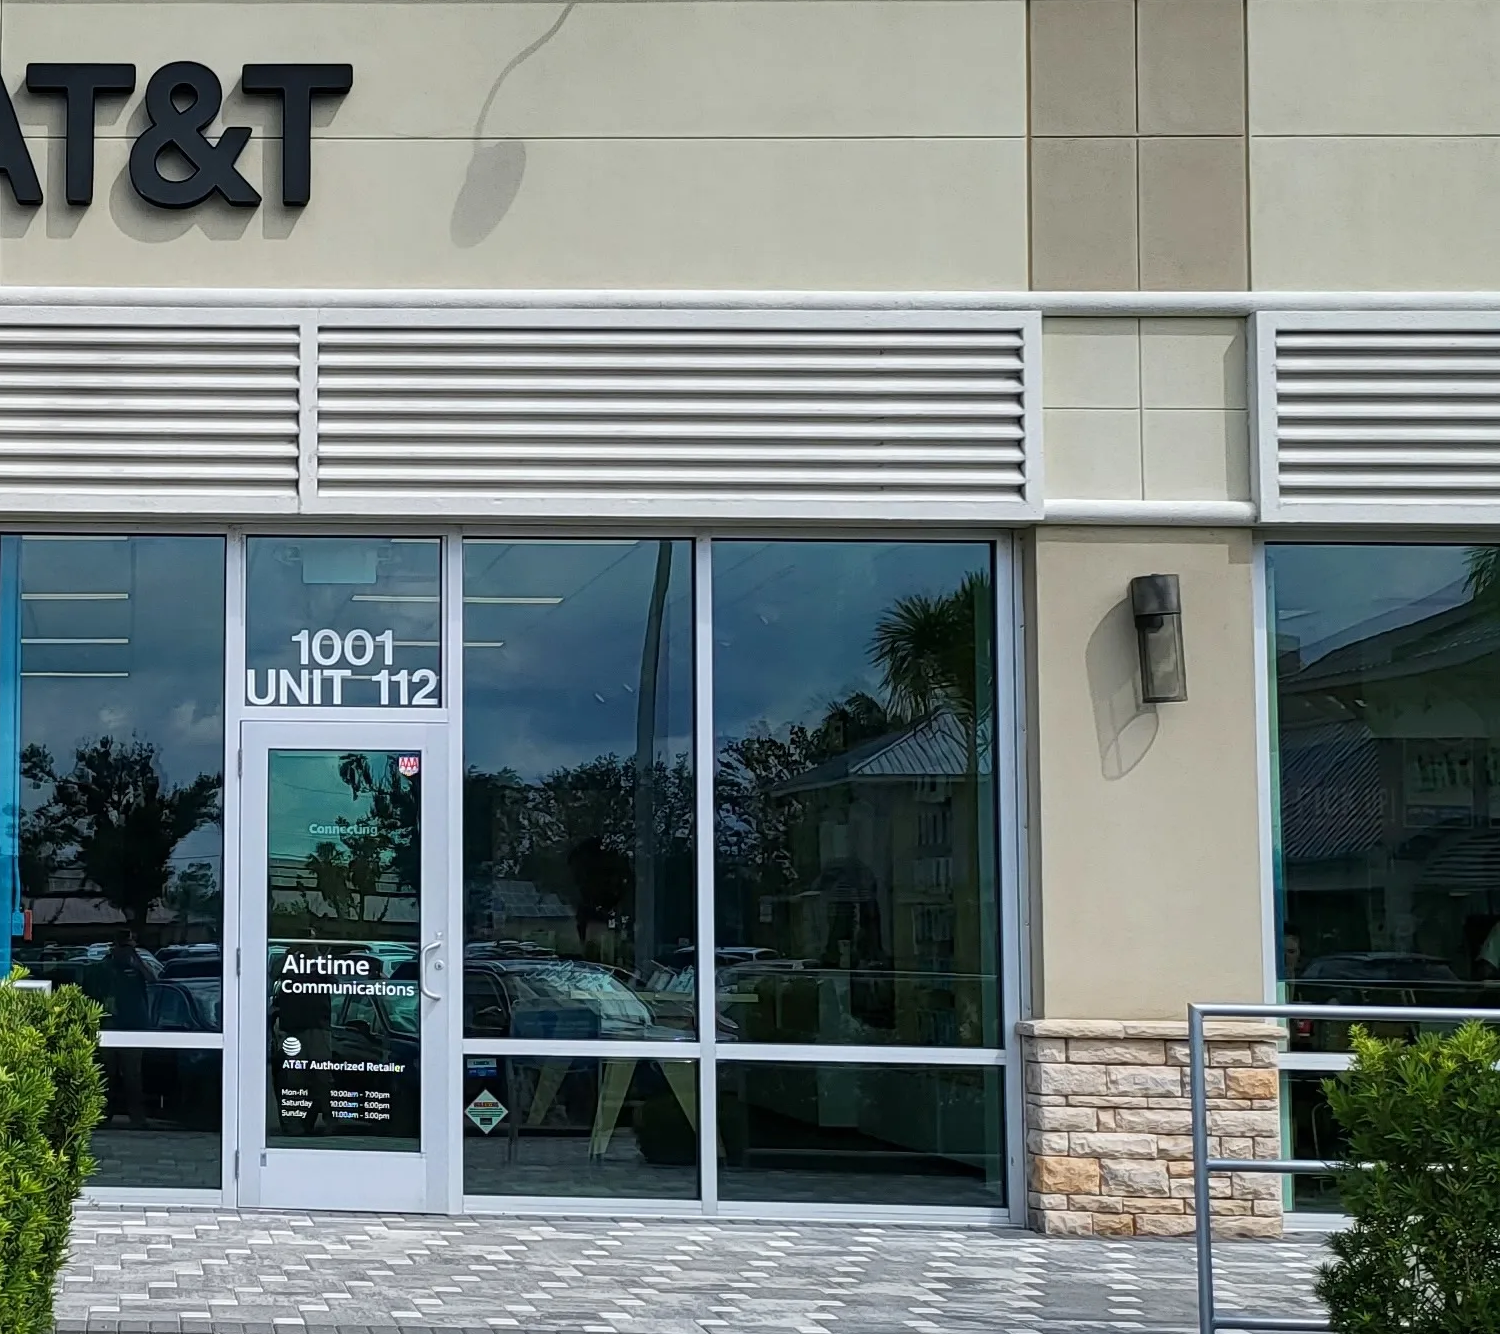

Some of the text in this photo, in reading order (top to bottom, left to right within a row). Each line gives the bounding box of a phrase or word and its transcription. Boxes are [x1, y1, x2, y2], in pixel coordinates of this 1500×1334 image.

[291, 629, 393, 666] 1001
[247, 668, 438, 705] UNIT 112
[400, 757, 418, 769] AAA
[309, 823, 378, 836] Connecting
[282, 954, 370, 976] Airtime
[281, 980, 415, 996] Communications
[282, 1060, 405, 1073] AT&T Authorized Retailer
[281, 1099, 313, 1108] Saturday
[281, 1110, 307, 1118] Sunday
